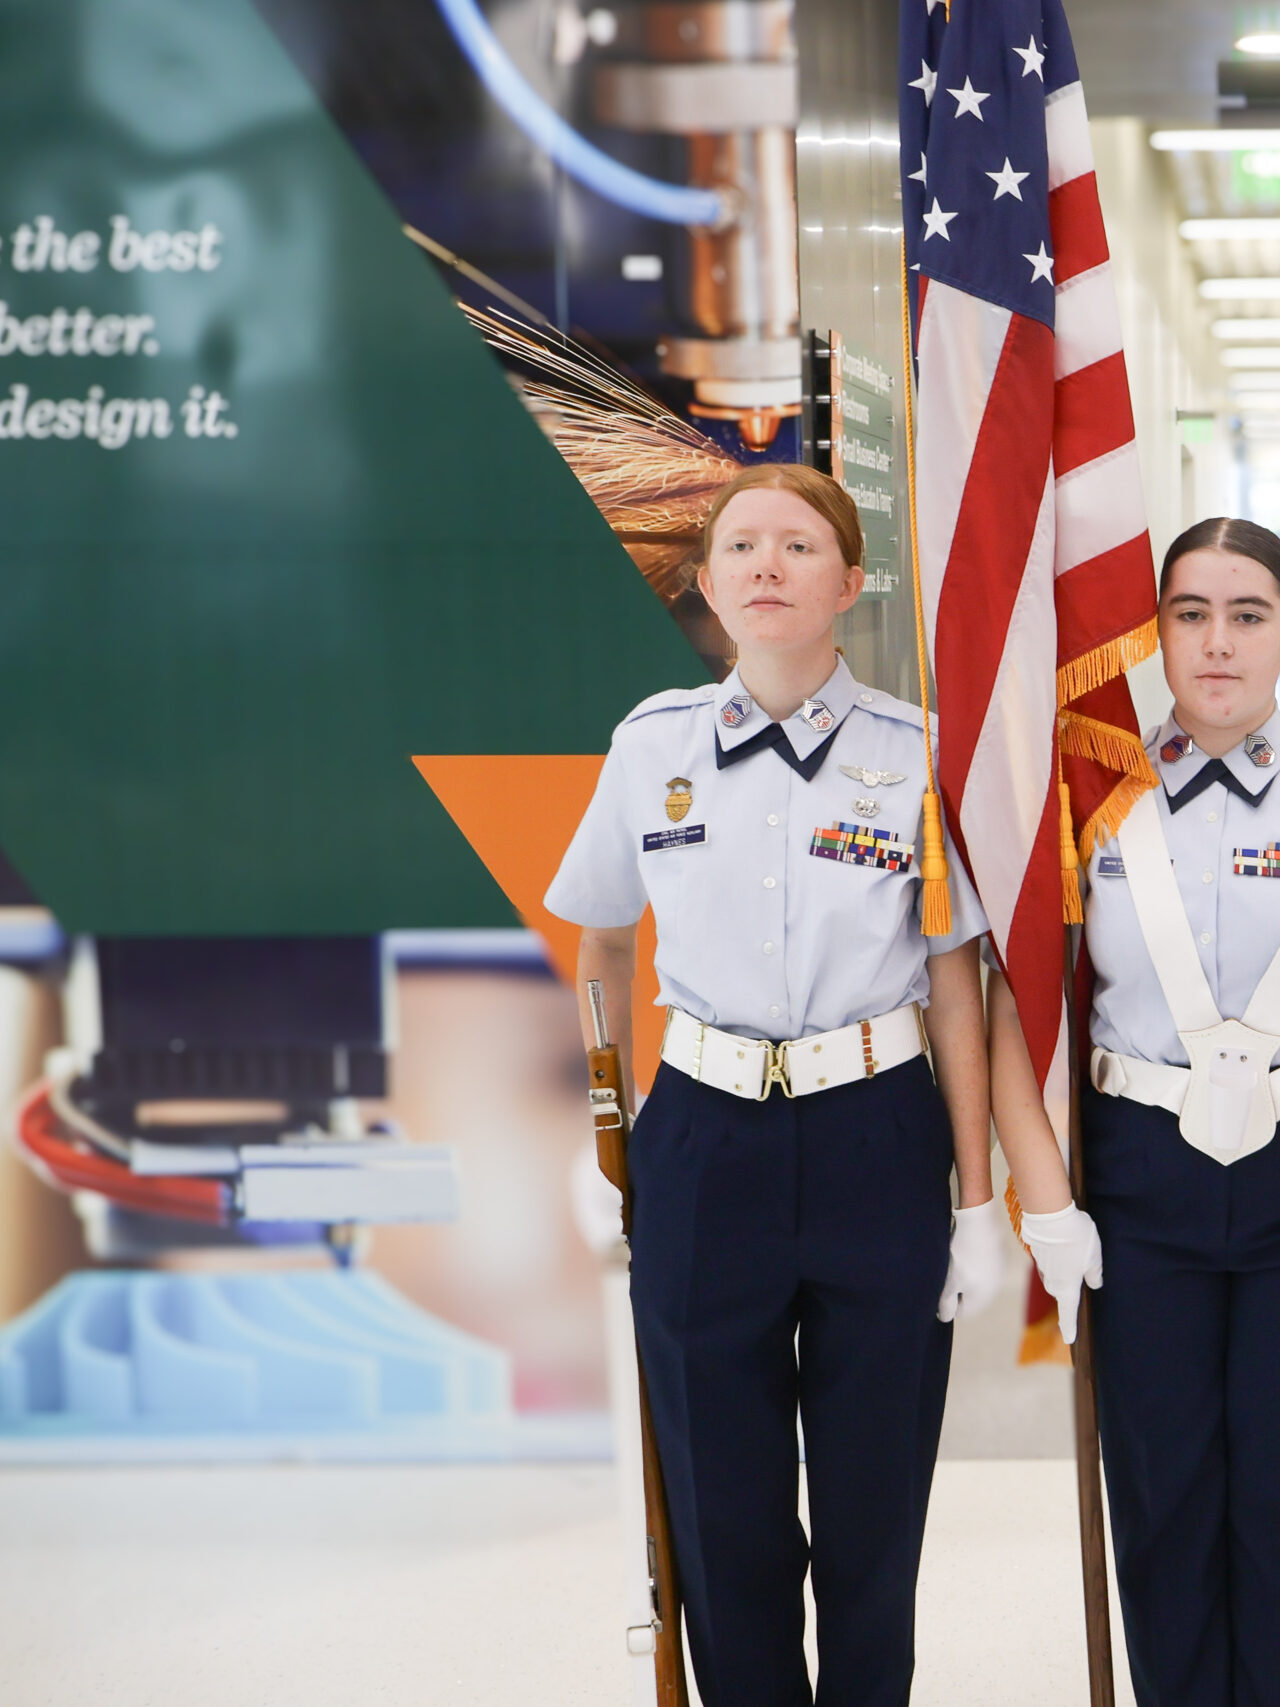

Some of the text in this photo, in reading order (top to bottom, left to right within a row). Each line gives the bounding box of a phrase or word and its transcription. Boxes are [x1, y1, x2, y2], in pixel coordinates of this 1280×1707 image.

[11, 214, 223, 272] the best
[0, 299, 159, 357] better.
[0, 382, 238, 450] design it.
[842, 434, 889, 473] Small Business Center
